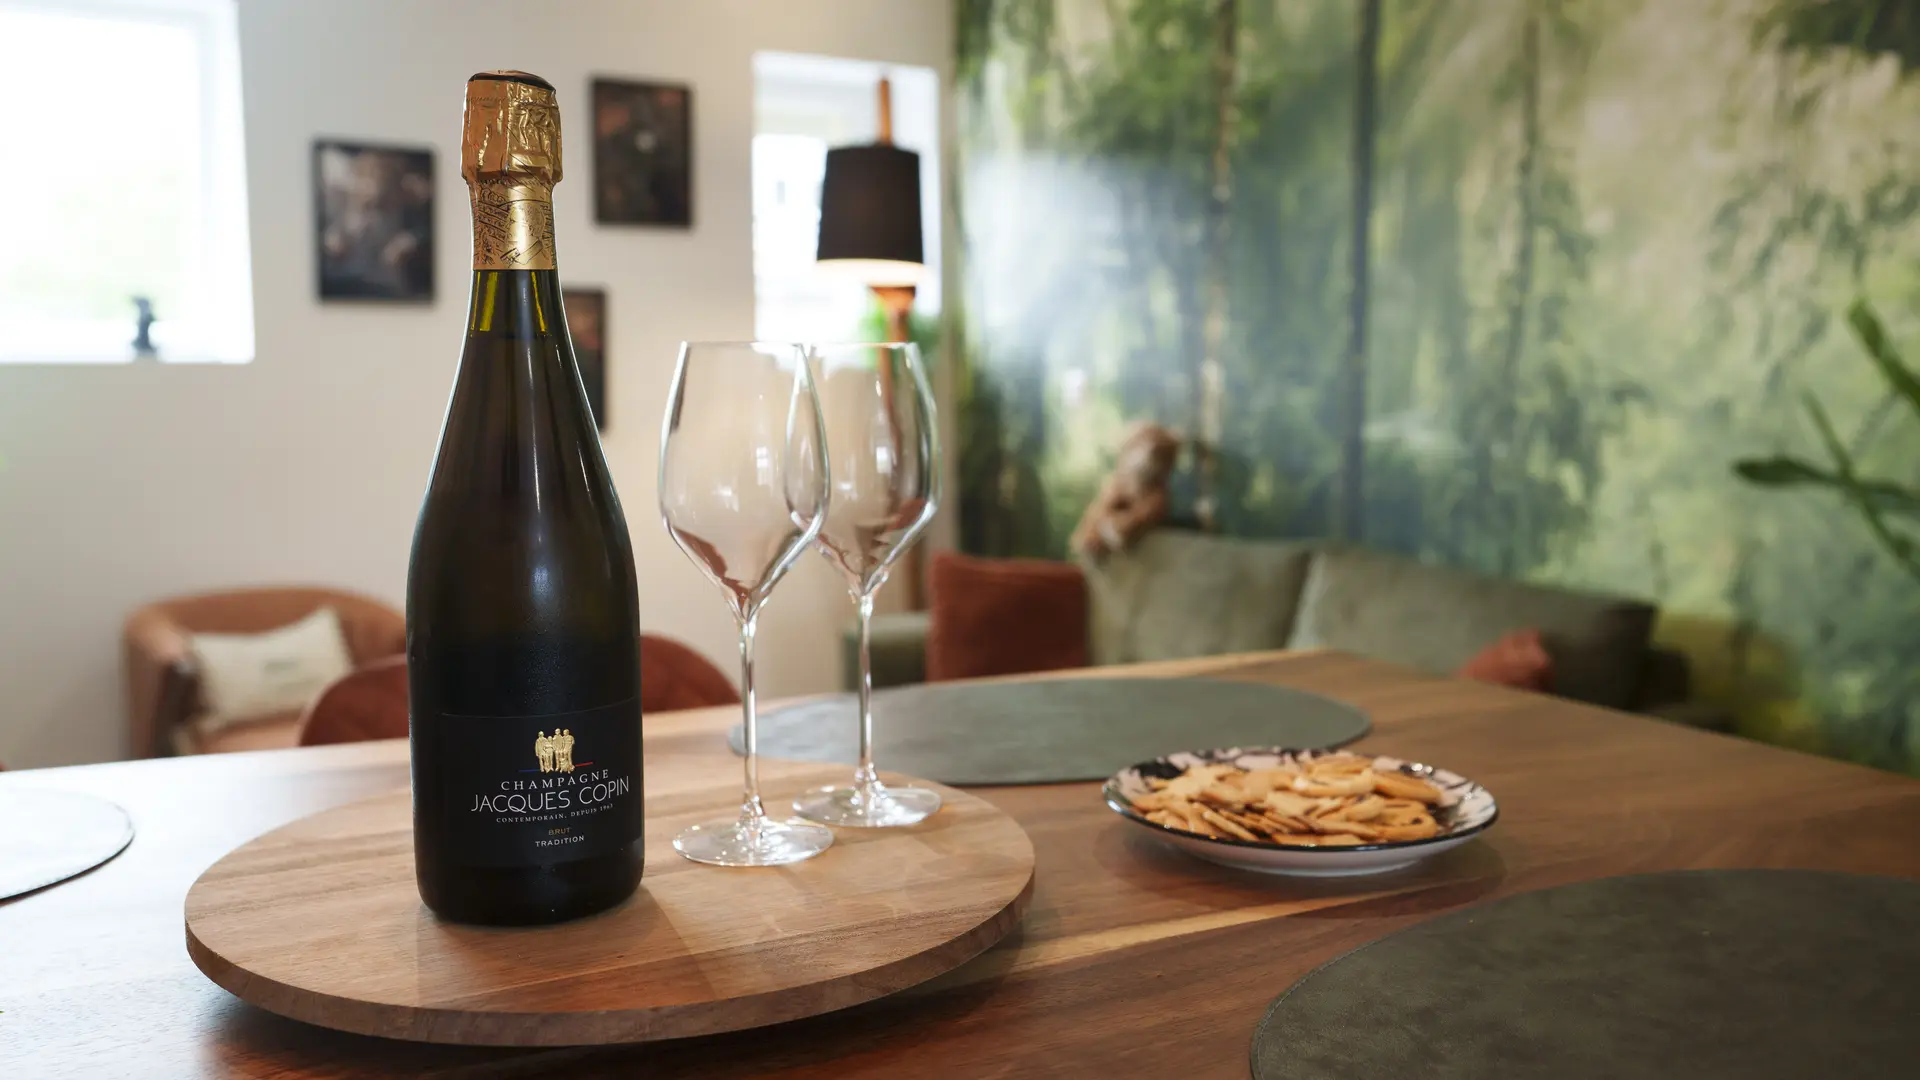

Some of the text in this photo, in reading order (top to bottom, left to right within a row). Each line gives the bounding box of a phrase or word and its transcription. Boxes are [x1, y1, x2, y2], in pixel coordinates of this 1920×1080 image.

[501, 769, 609, 790] CHAMPAGNE
[471, 776, 629, 813] JACQUES COPIN
[496, 814, 567, 823] CONTEMPORAIN,
[570, 807, 597, 817] DEPUIS
[548, 827, 571, 835] BRUT
[535, 835, 584, 847] TRADITION
